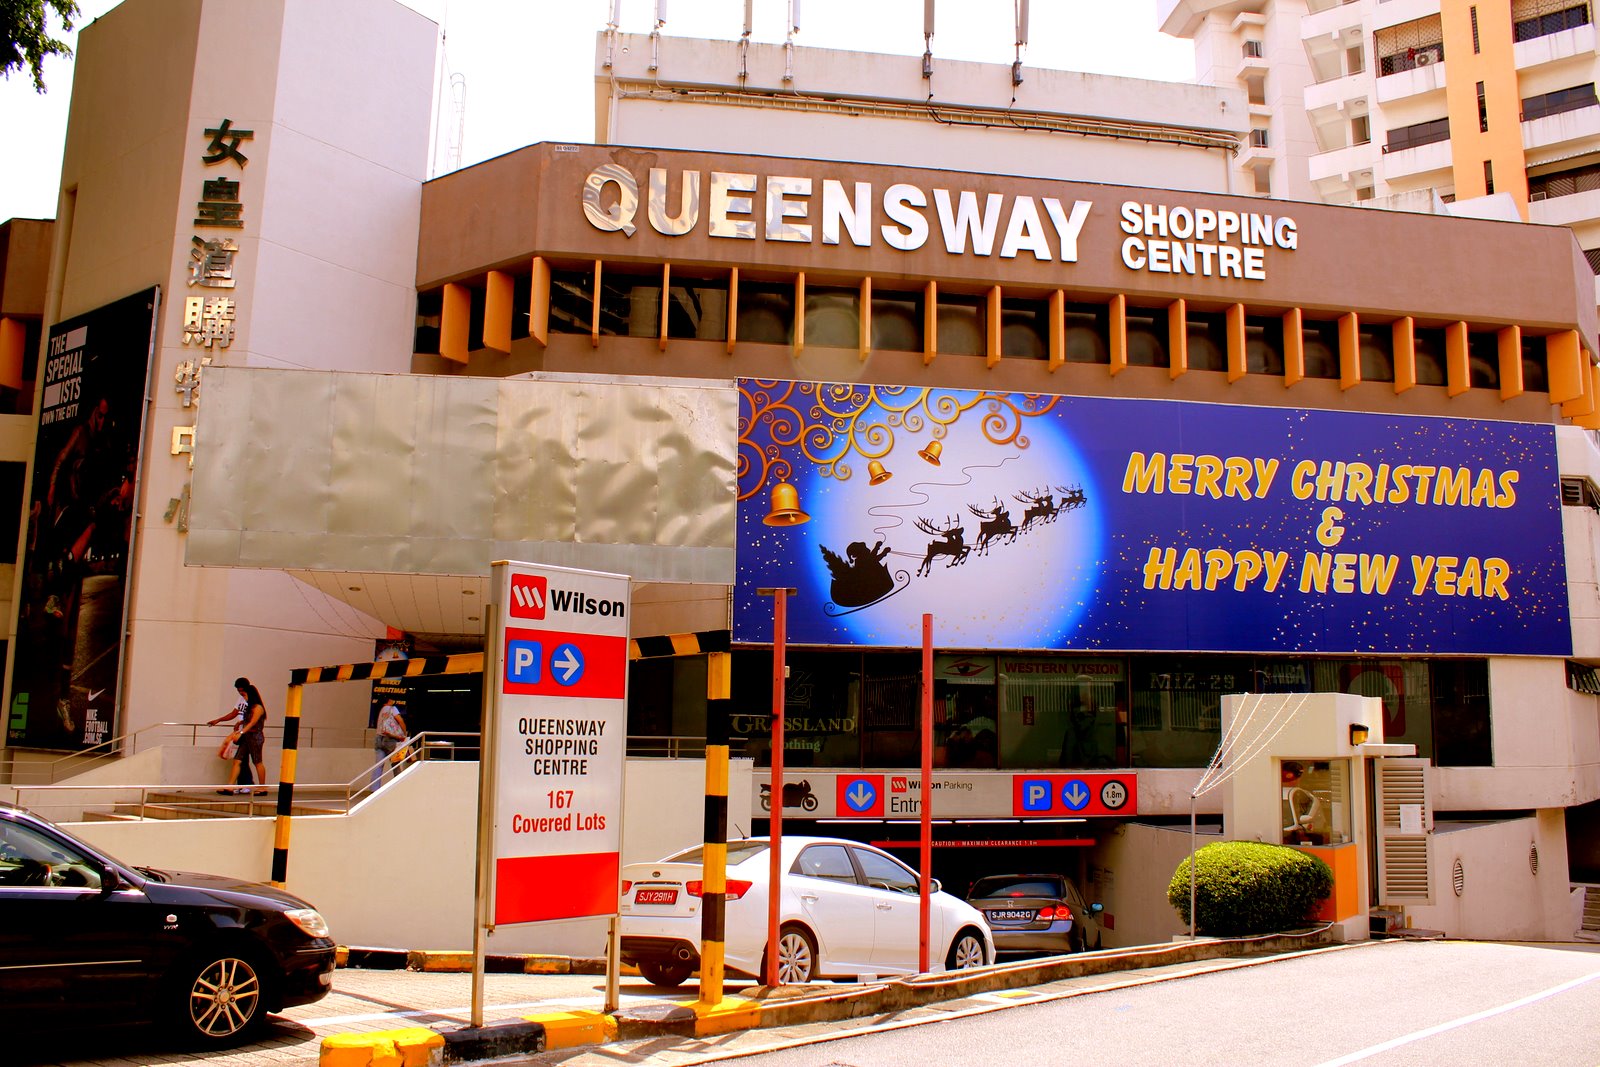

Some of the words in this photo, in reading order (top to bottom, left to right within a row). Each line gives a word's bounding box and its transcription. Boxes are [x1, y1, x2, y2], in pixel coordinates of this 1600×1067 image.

[582, 163, 1093, 262] QUEENSWAY
[1120, 201, 1298, 250] SHOPPING
[1121, 240, 1266, 280] CENTRE
[50, 333, 67, 357] THE
[46, 350, 84, 383] SPECIAL
[60, 376, 82, 404] ISTS
[41, 409, 55, 426] OWN
[55, 406, 66, 422] THE
[1122, 451, 1280, 501] MERRY
[1291, 459, 1520, 509] CHRISTMAS
[1316, 506, 1346, 548] &
[1142, 546, 1289, 594] HAPPY
[1298, 551, 1400, 595] NEW
[1411, 554, 1511, 601] YEAR
[550, 589, 625, 618] Wilson
[514, 647, 534, 676] P
[1005, 662, 1068, 674] WESTERN
[1072, 662, 1119, 675] VISION
[86, 708, 98, 721] NIKE
[85, 721, 108, 733] FOOTBALL
[518, 717, 607, 736] QUEENSWAY
[730, 716, 855, 734] GRSSLAND
[525, 738, 599, 756] SHOPPING
[768, 738, 821, 753] othing
[533, 759, 588, 775] CENTRE
[908, 780, 942, 790] Wion
[943, 780, 973, 791] Parking
[1029, 785, 1045, 806] P
[1105, 790, 1123, 799] 1.8m
[547, 790, 574, 809] 167
[512, 813, 571, 834] Covered
[576, 812, 606, 832] Lots
[991, 910, 1031, 919] SJR9042G
